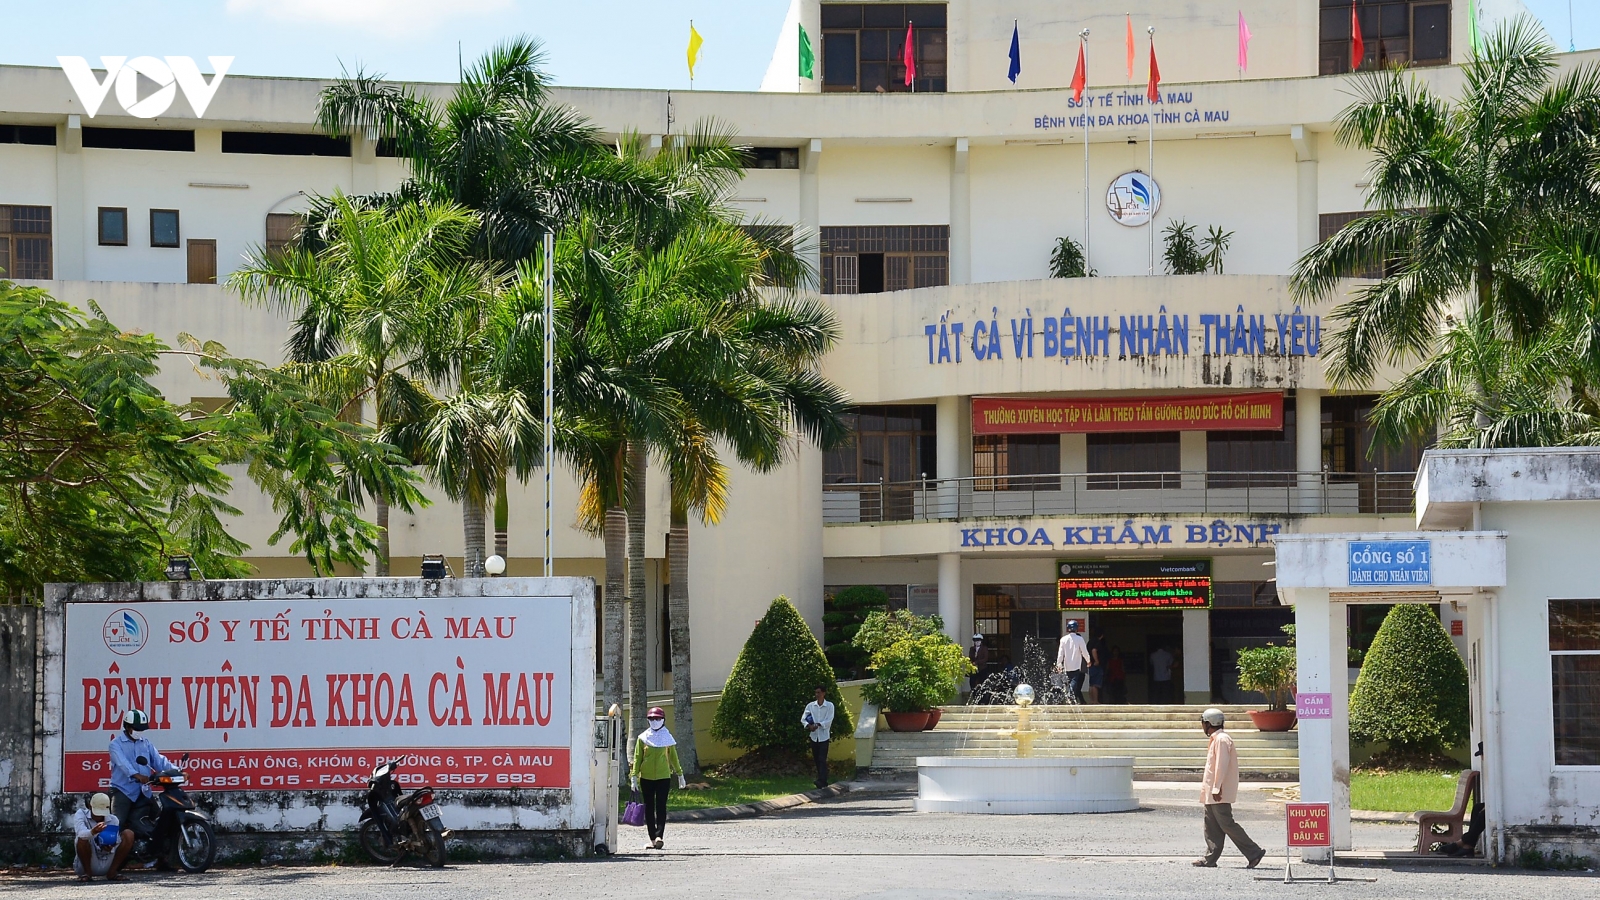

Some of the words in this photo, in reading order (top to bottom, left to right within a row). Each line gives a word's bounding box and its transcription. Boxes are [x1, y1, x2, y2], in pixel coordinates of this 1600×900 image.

[1088, 96, 1094, 108] Y
[1098, 92, 1113, 106] TẾ
[1117, 91, 1143, 106] TỈNH
[1168, 92, 1193, 104] MAU
[1034, 115, 1065, 130] BỆNH
[1069, 114, 1094, 129] VIỆN
[1098, 115, 1114, 126] ĐA
[1118, 114, 1149, 126] KHOA
[1154, 109, 1180, 124] TỈNH
[1184, 109, 1200, 122] CÀ
[1204, 110, 1230, 122] MAU
[924, 309, 964, 364] TẤT
[973, 306, 1003, 362] CẢ
[1011, 308, 1033, 358] VÌ
[1044, 307, 1110, 365] BỆNH
[1119, 305, 1188, 357] NHÂN
[1200, 304, 1264, 356] THÂN
[1275, 306, 1320, 356] YÊU
[984, 406, 1016, 424] THƯỜNG
[1018, 406, 1044, 423] XUYÊN
[1046, 410, 1062, 427] HỌC
[1065, 405, 1080, 426] TẬP
[1082, 404, 1092, 422] VÀ
[1094, 404, 1110, 422] LÀM
[1113, 407, 1134, 422] THEO
[1136, 402, 1152, 421] TẤM
[1184, 406, 1200, 424] ĐẠO
[1203, 402, 1219, 420] ĐỨC
[1222, 399, 1232, 420] HỒ
[1235, 401, 1248, 420] CHÍ
[1250, 404, 1272, 419] MINH
[960, 527, 1053, 547] KHOA
[1063, 520, 1172, 545] KHÁM
[1185, 520, 1282, 547] BỆNH
[1352, 544, 1392, 564] CỔNG
[1396, 546, 1415, 564] SỐ
[1420, 552, 1428, 564] 1
[1352, 568, 1372, 582] DÀNH
[1374, 570, 1388, 582] CHO
[1390, 568, 1410, 582] NHÂN
[1411, 567, 1428, 582] VIÊN
[1176, 588, 1192, 596] khoa
[169, 612, 210, 644] SỞ
[220, 620, 240, 642] Y
[250, 608, 292, 641] TẾ
[302, 608, 380, 640] TỈNH
[390, 610, 433, 640] CÀ
[444, 616, 516, 639] MAU
[81, 660, 172, 743] BỆNH
[182, 659, 260, 743] VIỆN
[270, 674, 316, 728] ĐA
[326, 672, 418, 728] KHOA
[428, 656, 472, 727] CÀ
[482, 672, 554, 727] MAU
[1304, 696, 1324, 704] CẤM
[1298, 707, 1316, 716] ĐẬU
[82, 758, 102, 770] Số
[228, 758, 258, 768] LÃN
[264, 756, 302, 770] ÔNG,
[308, 754, 353, 767] KHÓM
[358, 756, 370, 768] 6,
[446, 756, 459, 768] 6,
[464, 756, 486, 766] TP.
[492, 753, 515, 766] CÀ
[519, 756, 552, 766] MAU
[200, 776, 251, 786] 3831
[260, 775, 299, 785] 015
[436, 774, 488, 784] 3567
[496, 774, 536, 783] 693
[1310, 809, 1326, 818] VỰC
[1299, 818, 1318, 828] CẤM
[1293, 830, 1310, 842] ĐẬU
[1314, 832, 1324, 840] XE
